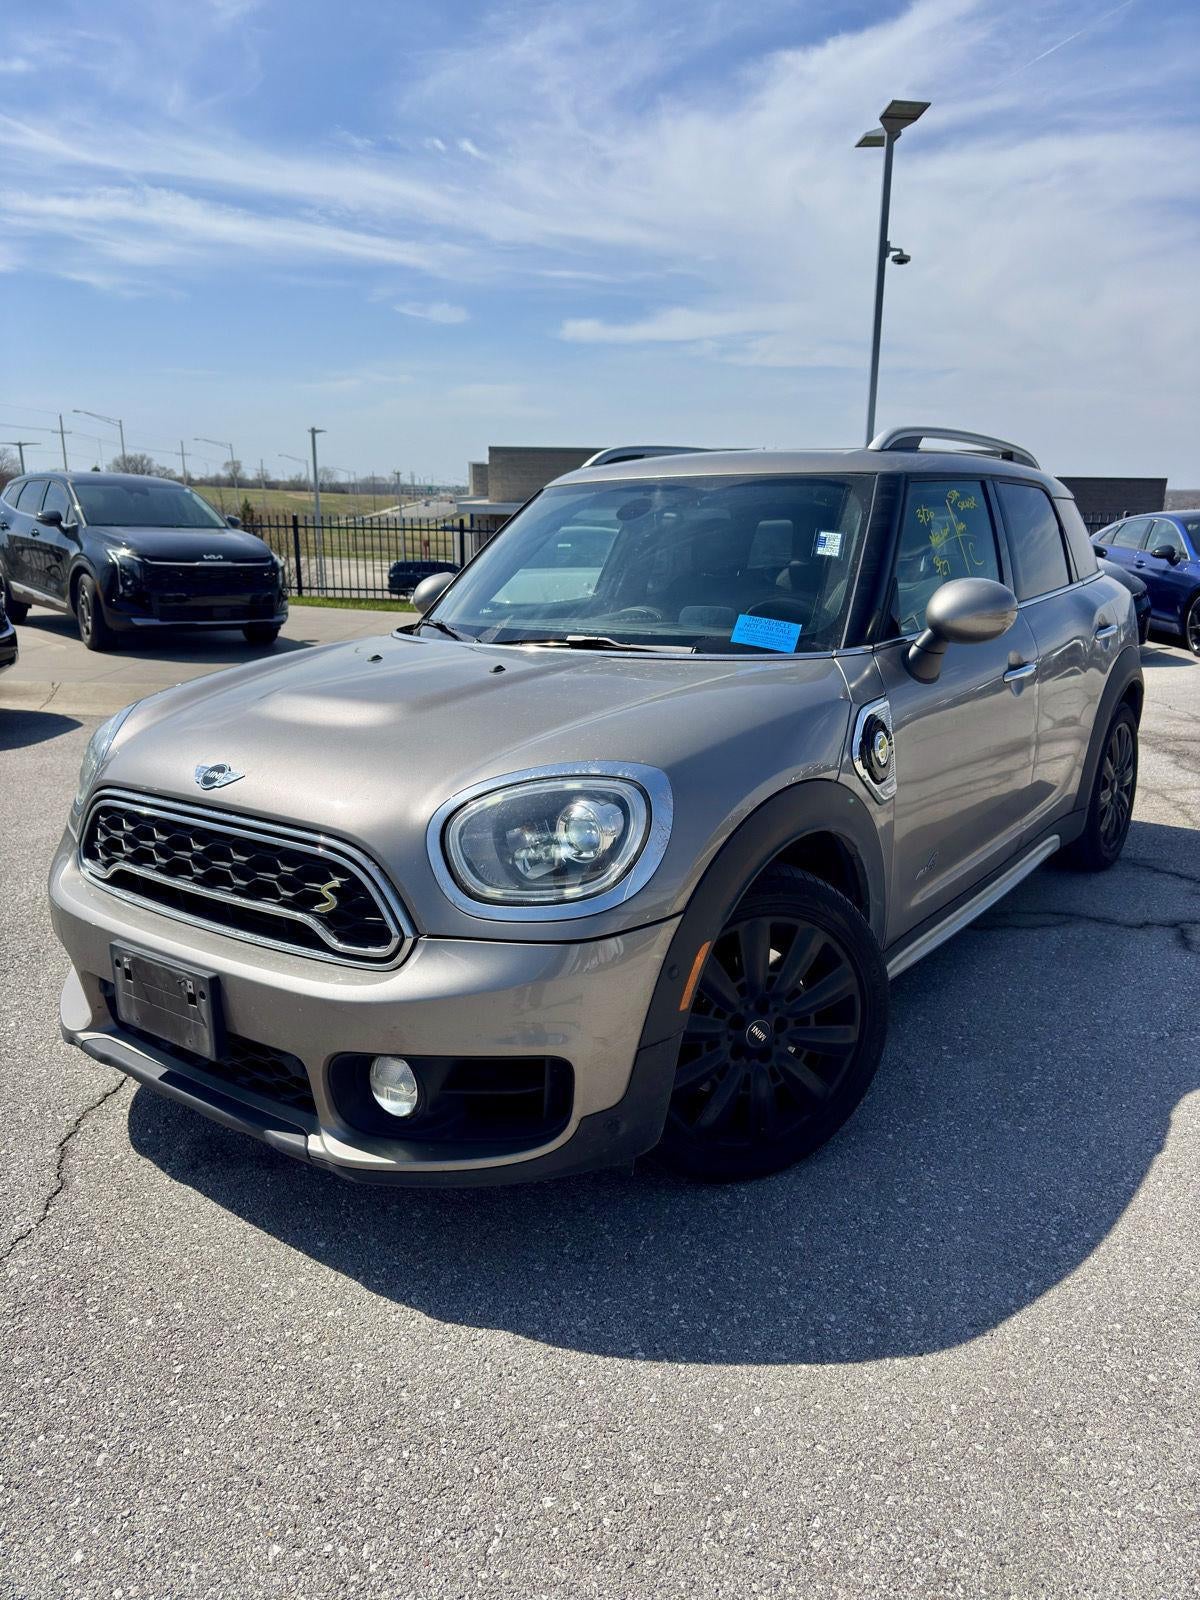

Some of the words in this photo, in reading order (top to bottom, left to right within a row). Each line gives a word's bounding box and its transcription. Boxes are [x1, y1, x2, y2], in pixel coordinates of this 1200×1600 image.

[743, 622, 758, 630] NOT
[760, 624, 774, 632] FOR
[775, 627, 792, 635] SALE
[749, 616, 763, 624] THIS
[765, 619, 792, 629] VEHICLE
[207, 770, 224, 780] MINI
[751, 1025, 767, 1041] MINI
